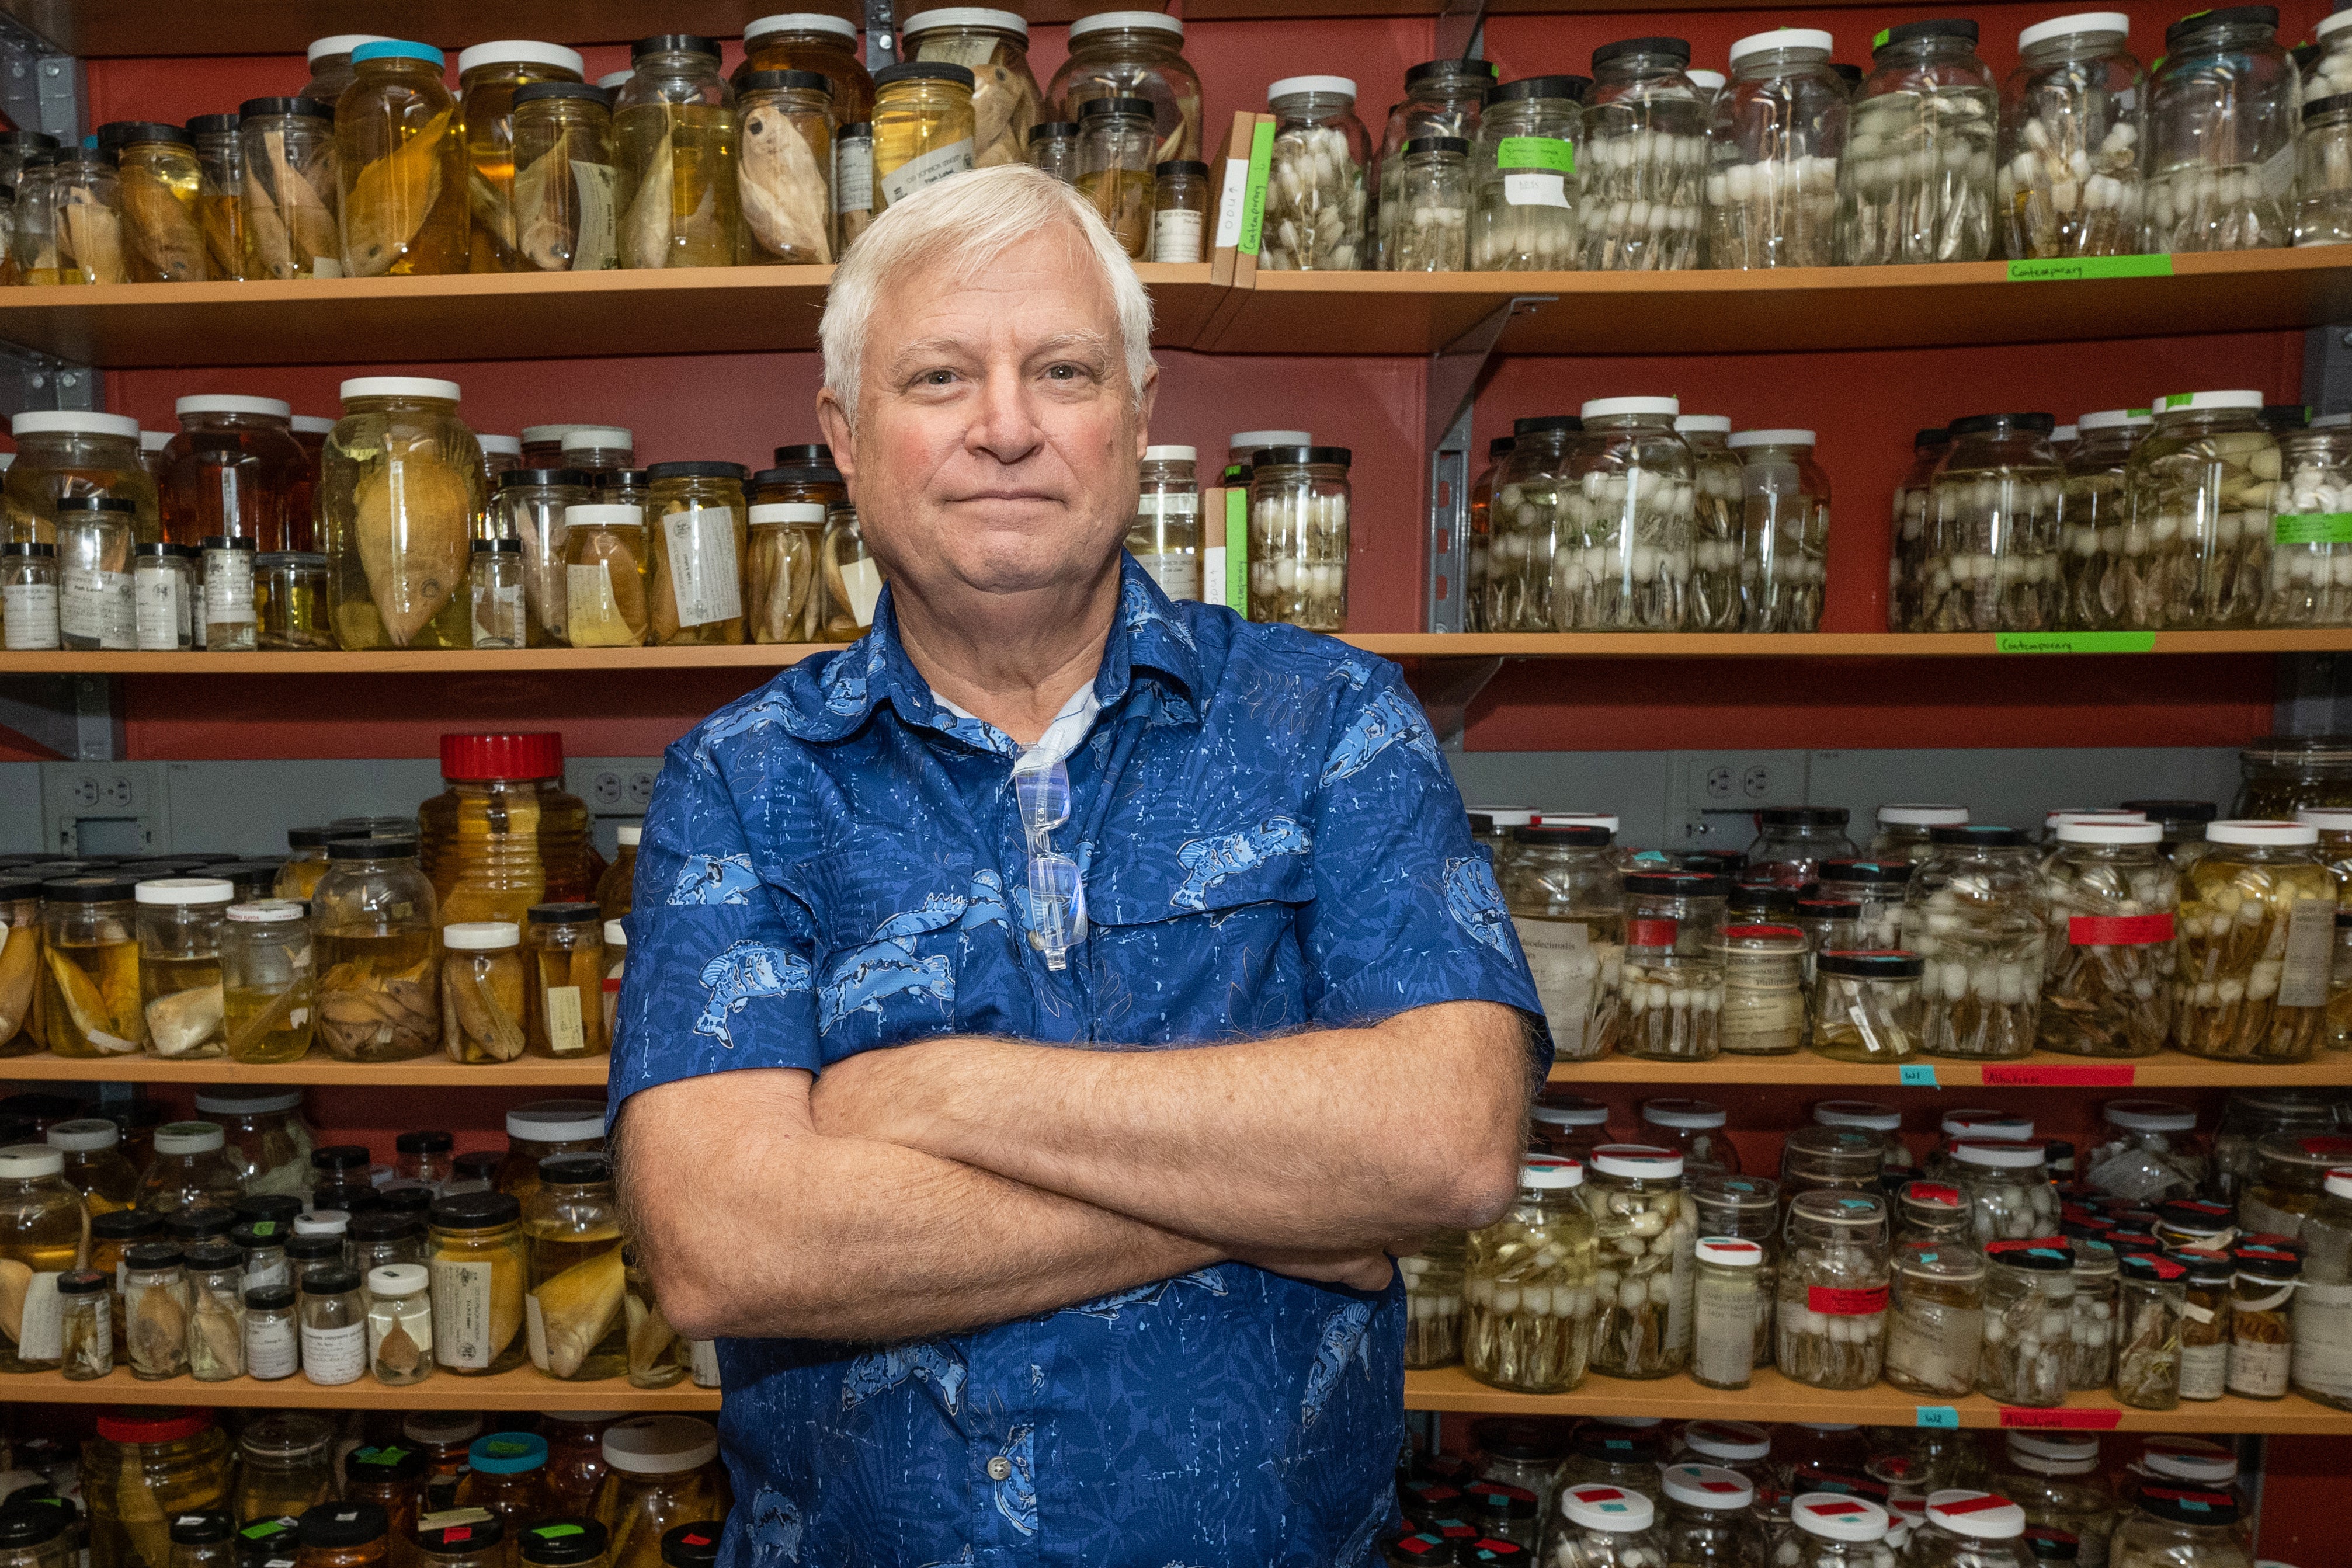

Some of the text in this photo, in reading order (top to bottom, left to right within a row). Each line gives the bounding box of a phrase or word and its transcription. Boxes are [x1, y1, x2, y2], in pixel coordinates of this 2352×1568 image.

[1243, 185, 1267, 250] Contemporary
[2011, 265, 2083, 279] Contemporary
[2002, 638, 2072, 651] Contemporary
[1925, 1413, 1942, 1424] W2
